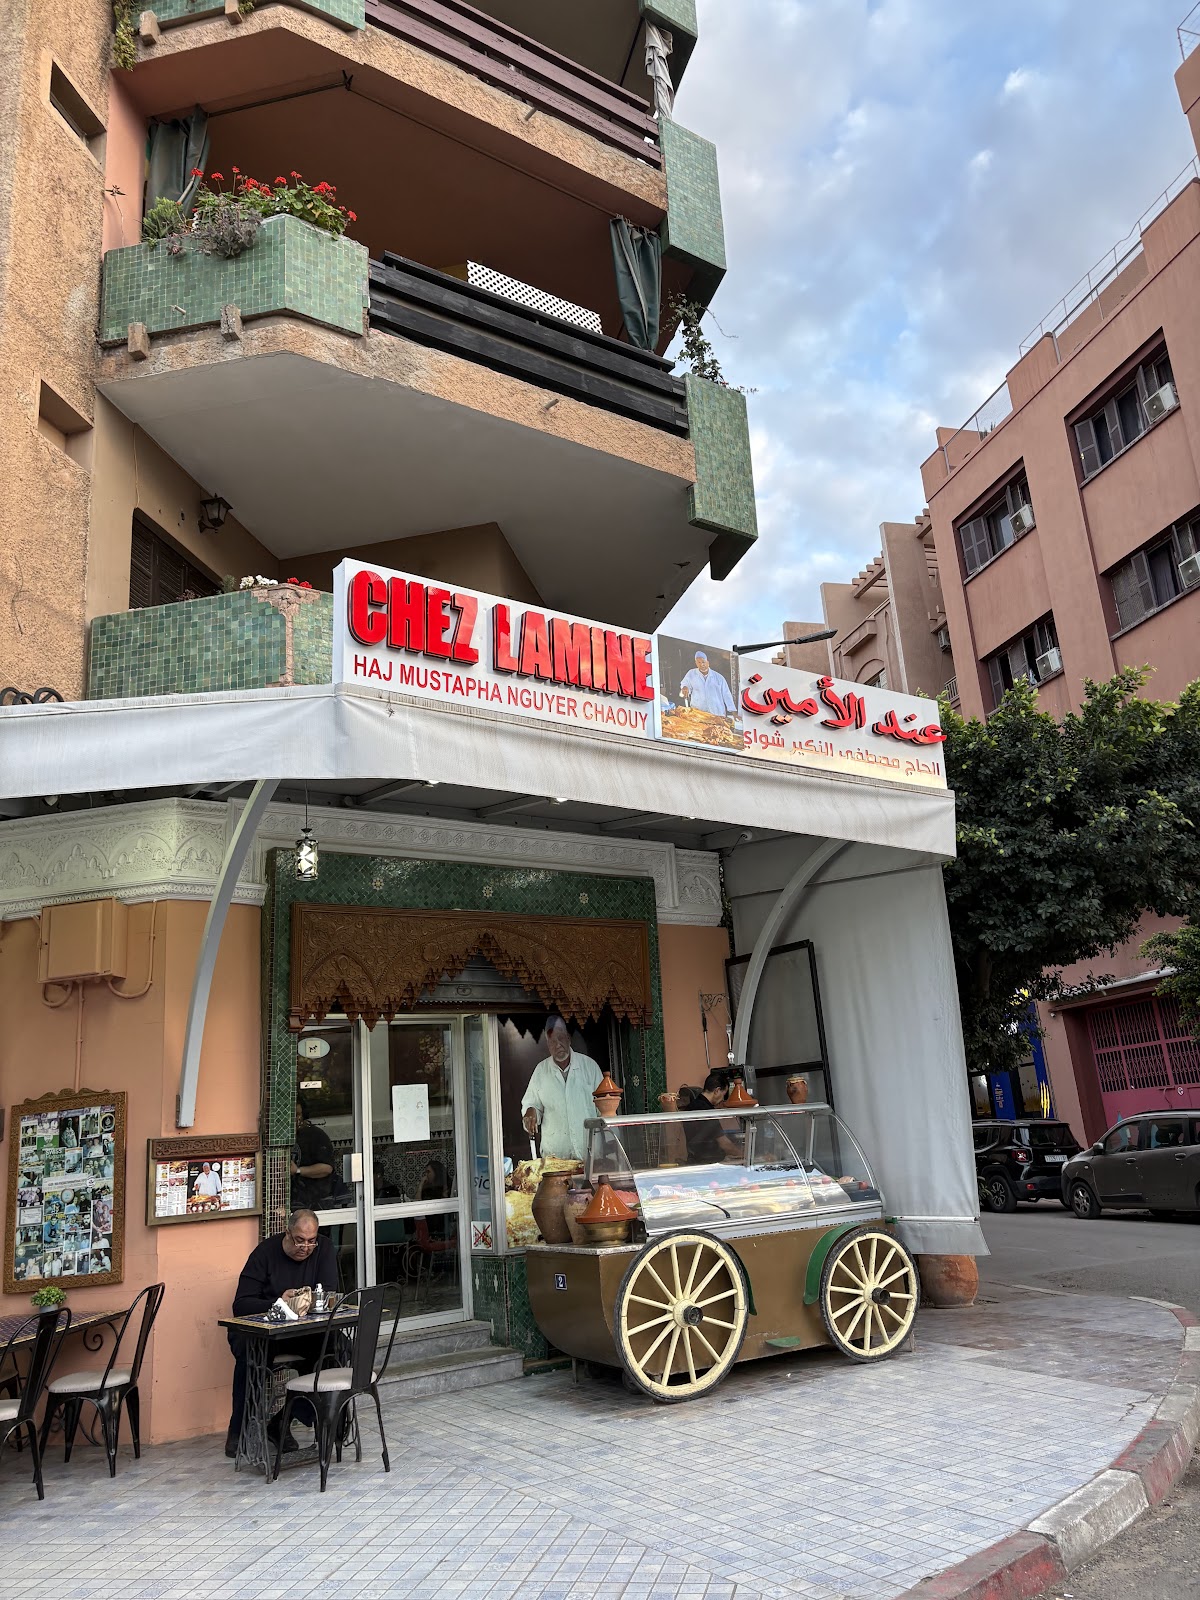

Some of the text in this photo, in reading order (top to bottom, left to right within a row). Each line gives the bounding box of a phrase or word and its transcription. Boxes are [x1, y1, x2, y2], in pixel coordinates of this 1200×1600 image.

[347, 570, 479, 665] CHEZ
[492, 603, 655, 702] LAMINE
[353, 654, 649, 731] HAJ MUSTAPHA NGUYER CHAOUY
[741, 673, 867, 730] الأمين
[743, 728, 940, 776] الحاج مصطفى النكير شواي
[872, 710, 947, 745] عند
[558, 1276, 564, 1288] 2
